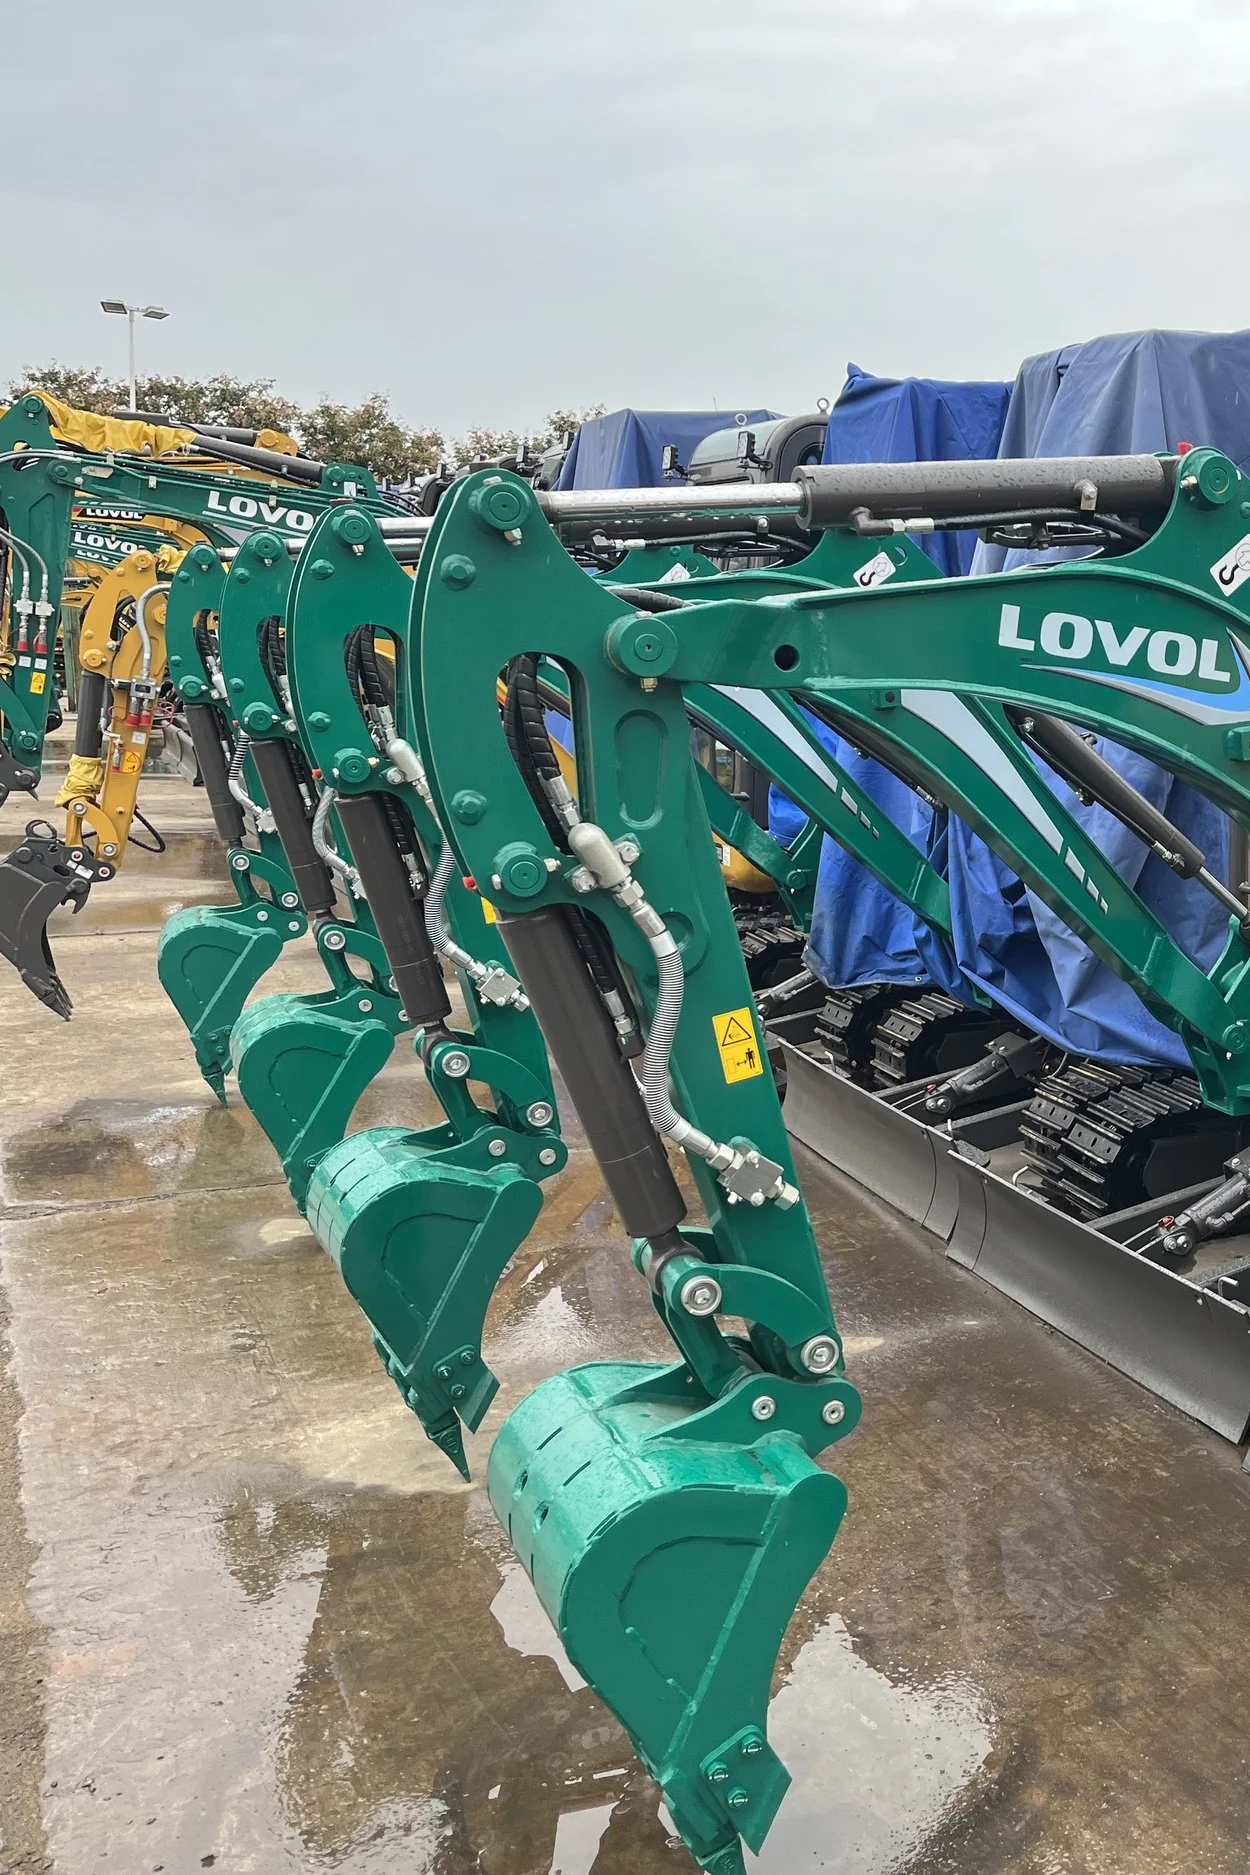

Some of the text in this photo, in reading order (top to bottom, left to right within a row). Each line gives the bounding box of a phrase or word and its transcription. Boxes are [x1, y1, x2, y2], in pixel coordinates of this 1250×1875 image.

[207, 490, 320, 531] LOVO
[74, 531, 147, 554] LOVO
[998, 603, 1231, 682] LOVOL
